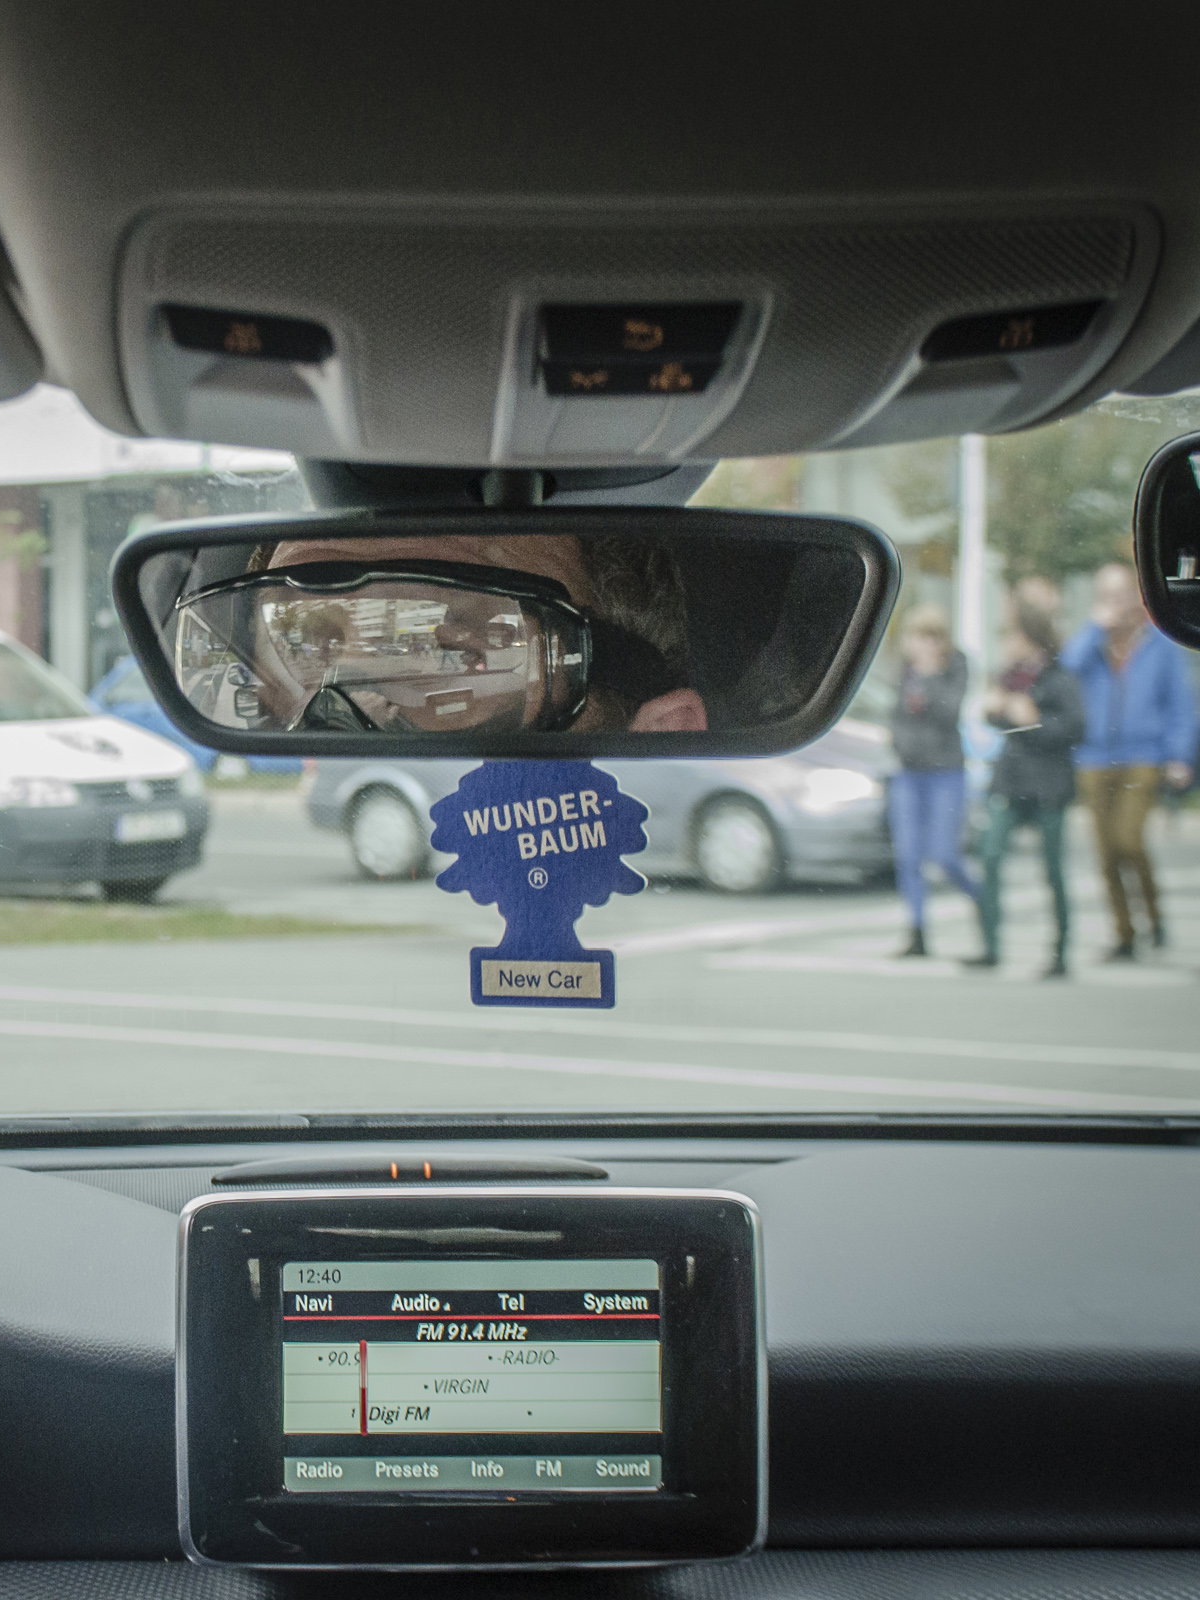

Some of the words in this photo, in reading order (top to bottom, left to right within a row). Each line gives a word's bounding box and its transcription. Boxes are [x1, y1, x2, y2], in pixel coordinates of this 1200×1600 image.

[463, 790, 613, 836] WUNDER-
[517, 821, 607, 860] BAUM
[499, 969, 541, 989] New
[547, 970, 583, 989] Car
[298, 1269, 342, 1284] 12:40
[295, 1294, 333, 1312] Navi
[391, 1293, 441, 1312] Audio
[497, 1292, 525, 1311] Tel
[583, 1292, 649, 1314] System
[416, 1322, 445, 1341] FM
[448, 1322, 484, 1341] 91.4
[487, 1322, 528, 1341] MHz
[434, 1379, 490, 1394] VIRGIN
[369, 1406, 401, 1425] Digi
[404, 1406, 431, 1421] FM
[296, 1461, 343, 1478] Radio
[375, 1461, 439, 1478] Presets
[471, 1460, 504, 1477] Info
[535, 1460, 562, 1477] FM
[596, 1459, 651, 1477] Sound
